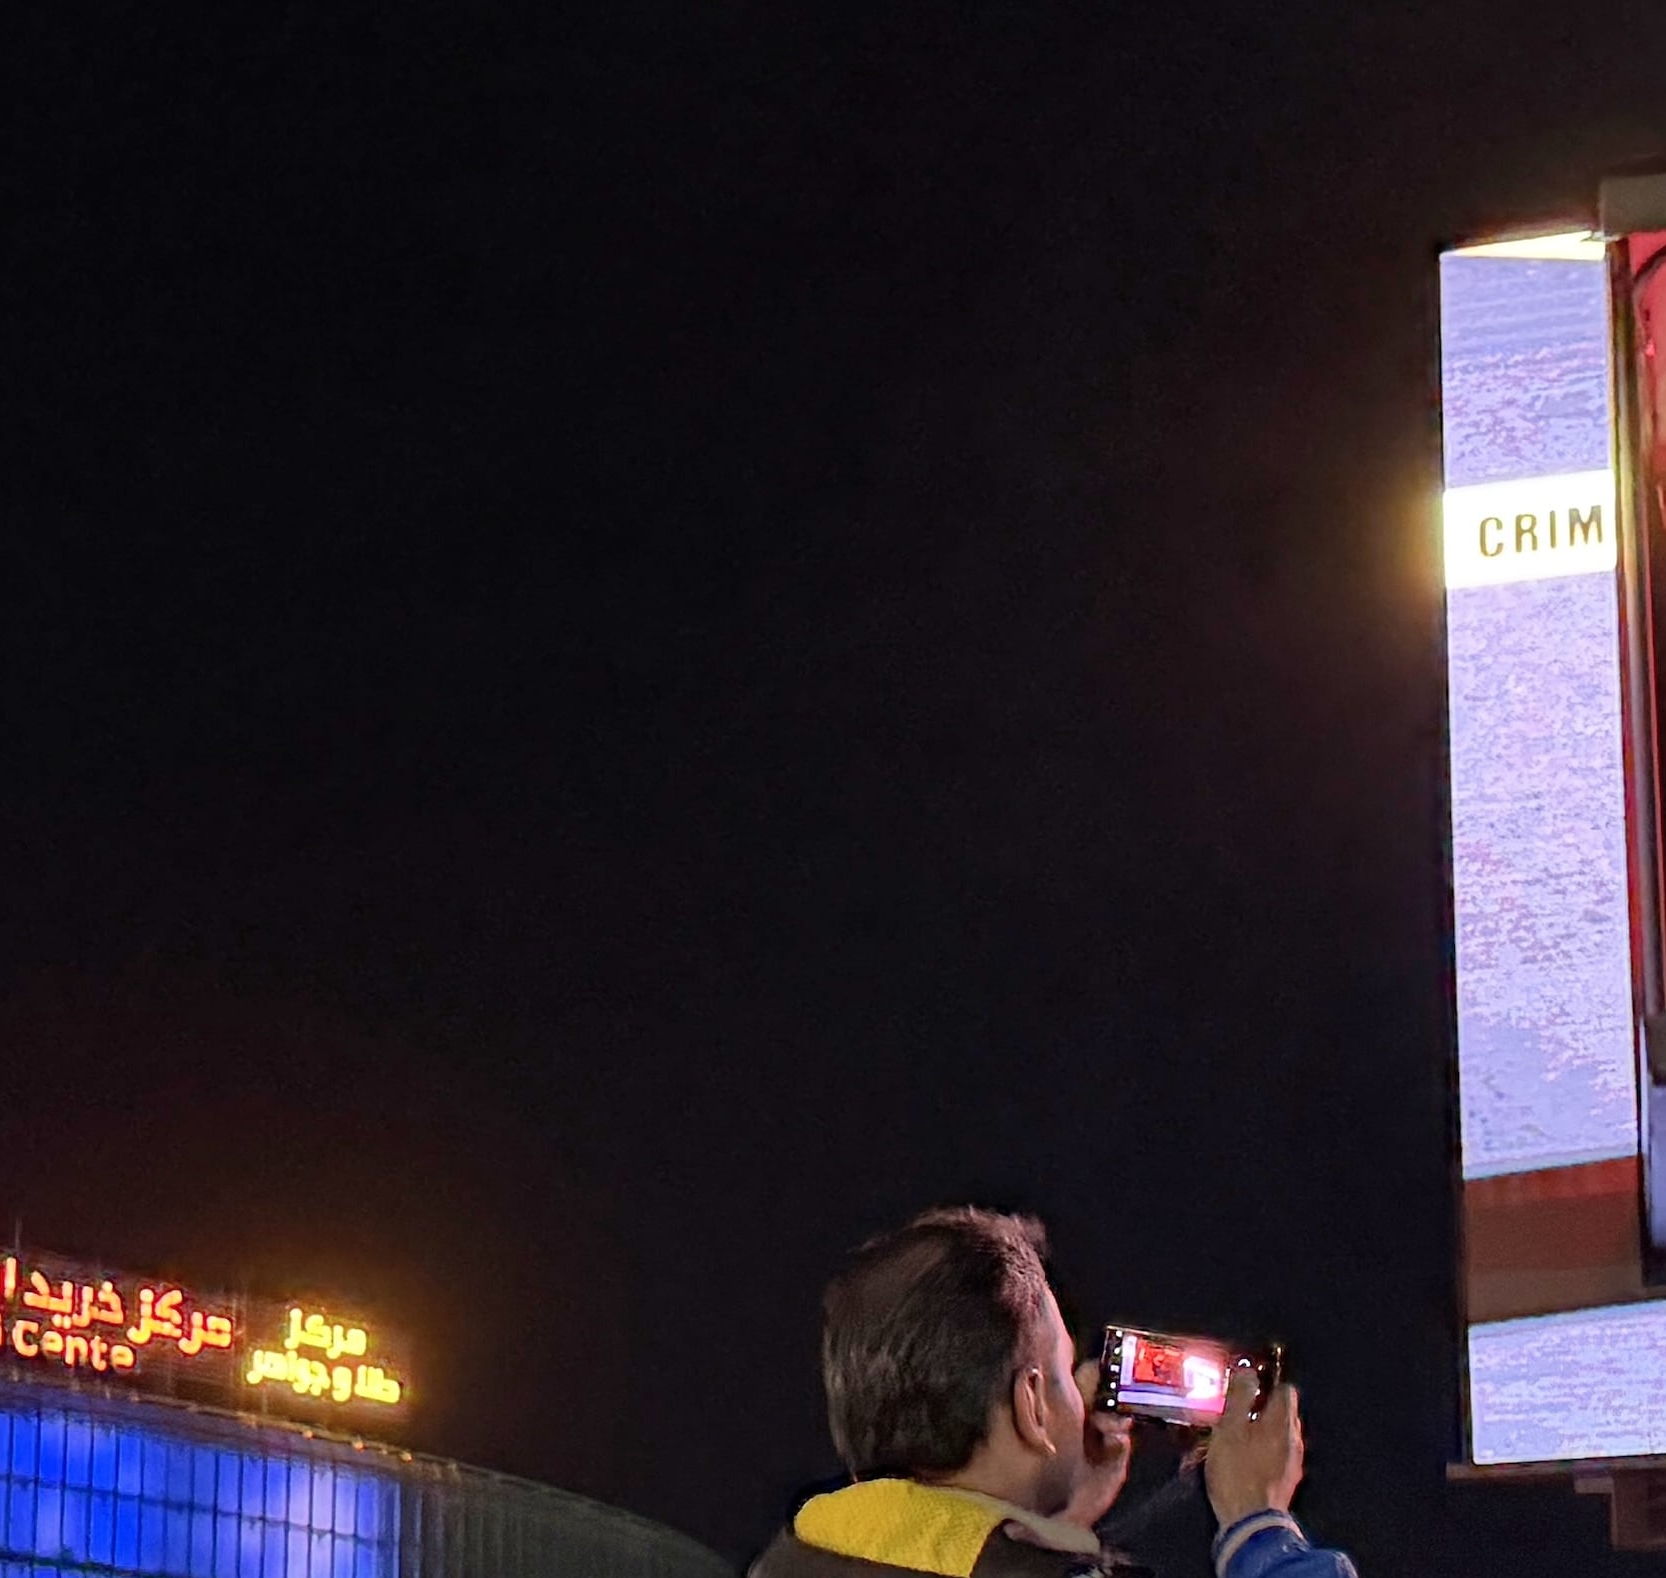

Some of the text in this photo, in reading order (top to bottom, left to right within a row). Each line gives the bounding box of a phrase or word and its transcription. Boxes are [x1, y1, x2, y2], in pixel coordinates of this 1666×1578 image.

[23, 1270, 125, 1329] خرید
[126, 1288, 232, 1355] مرکز
[284, 1307, 367, 1360] مرکز
